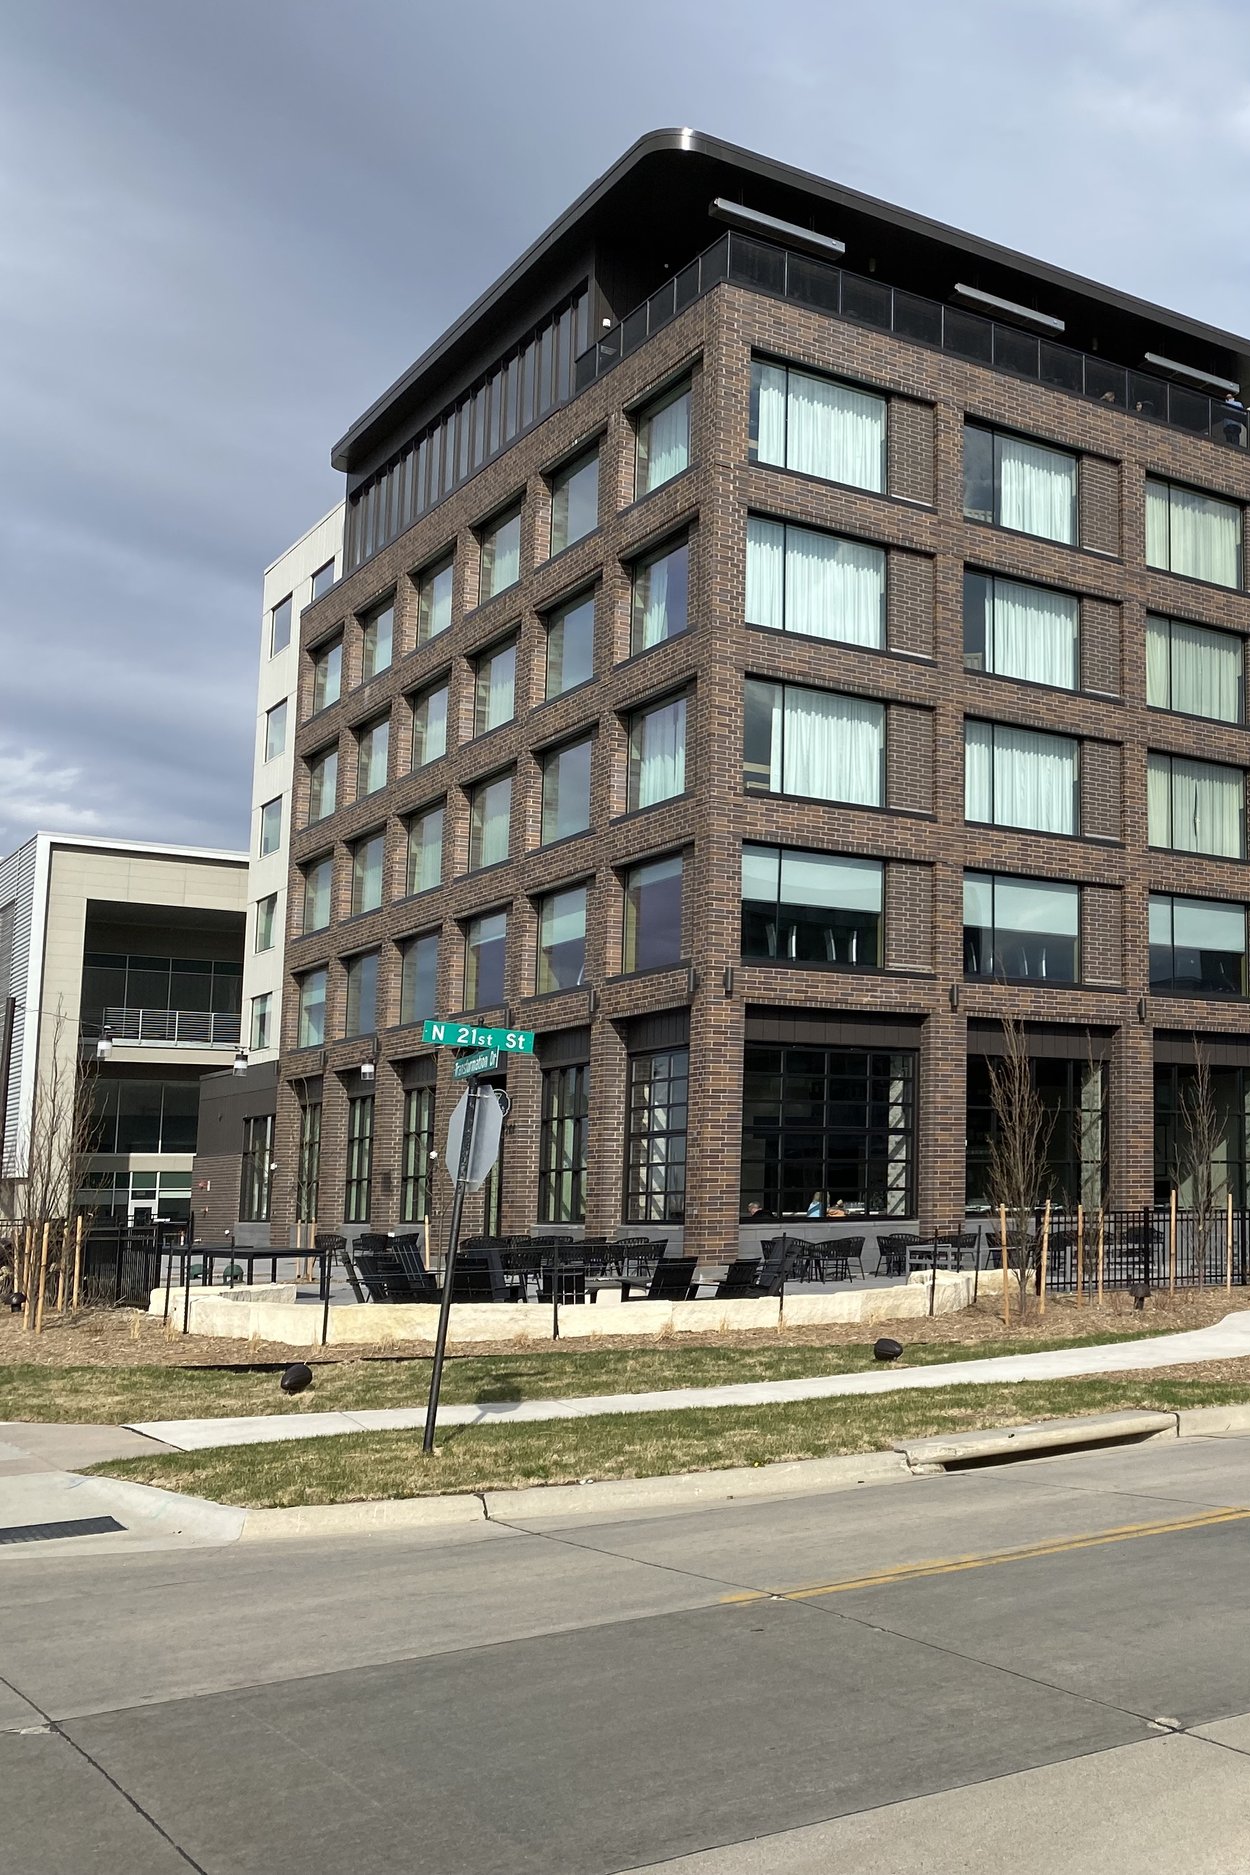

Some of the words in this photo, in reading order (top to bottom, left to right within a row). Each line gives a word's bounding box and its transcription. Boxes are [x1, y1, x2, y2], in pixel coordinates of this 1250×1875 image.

[431, 1024, 445, 1041] N
[457, 1027, 493, 1046] 21st
[505, 1033, 526, 1050] St
[454, 1055, 489, 1078] Transformation
